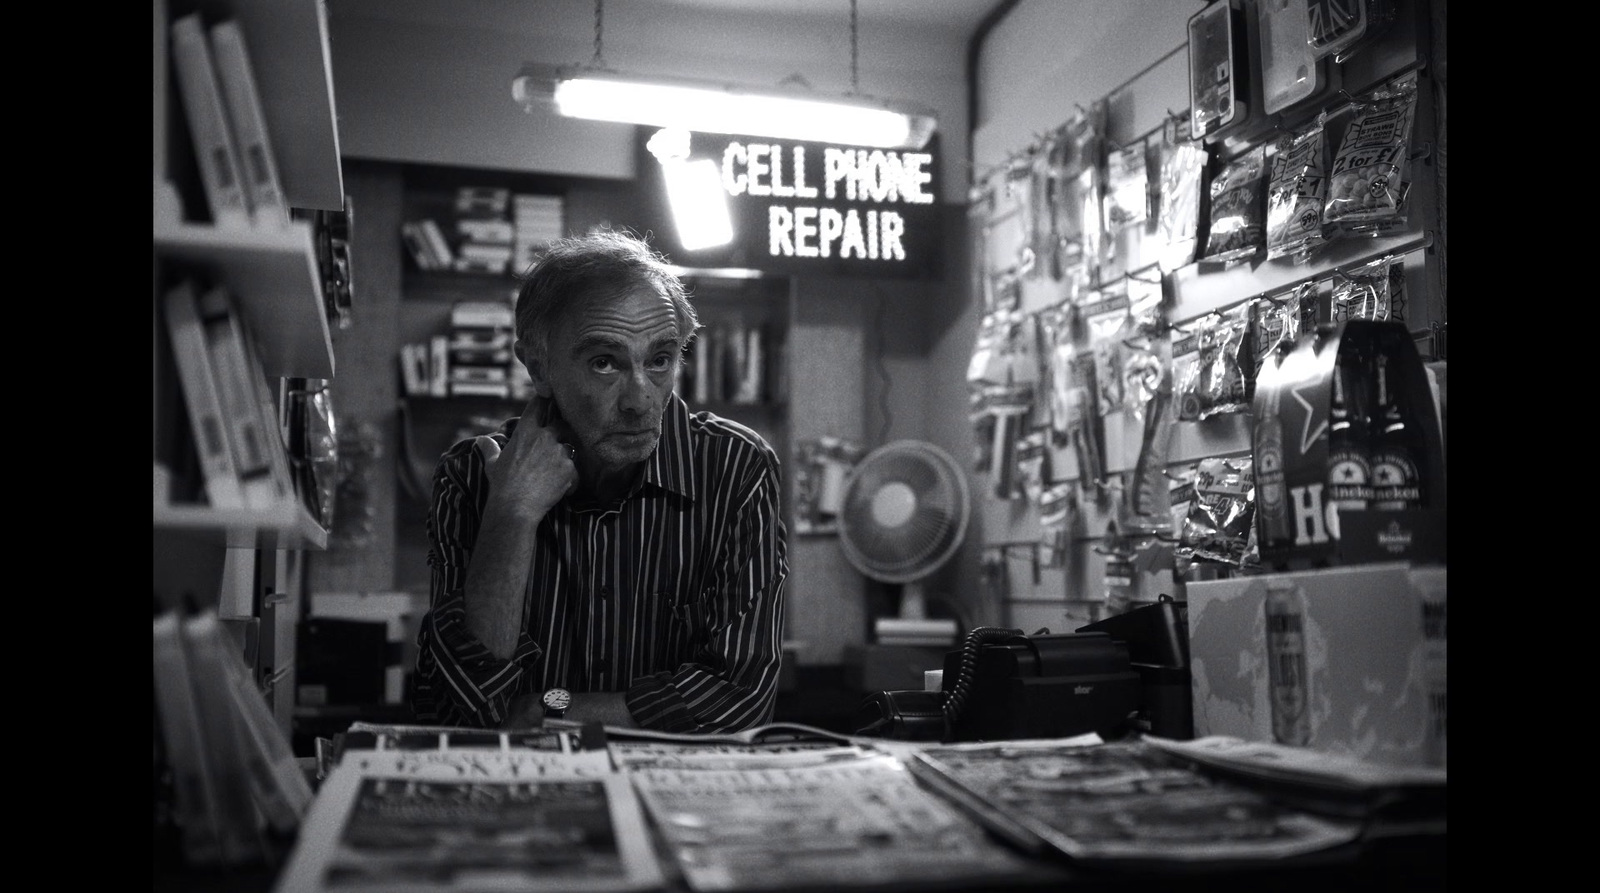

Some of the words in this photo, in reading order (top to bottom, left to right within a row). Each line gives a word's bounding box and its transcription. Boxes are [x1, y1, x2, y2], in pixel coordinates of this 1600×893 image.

[721, 141, 818, 198] CELL
[824, 148, 934, 204] PHONE
[1333, 157, 1346, 175] 2
[1349, 156, 1373, 169] for
[1373, 146, 1400, 163] £1
[1296, 177, 1320, 197] £1
[1302, 213, 1317, 226] 59p
[769, 205, 905, 260] REPAIR
[1214, 497, 1231, 515] 4
